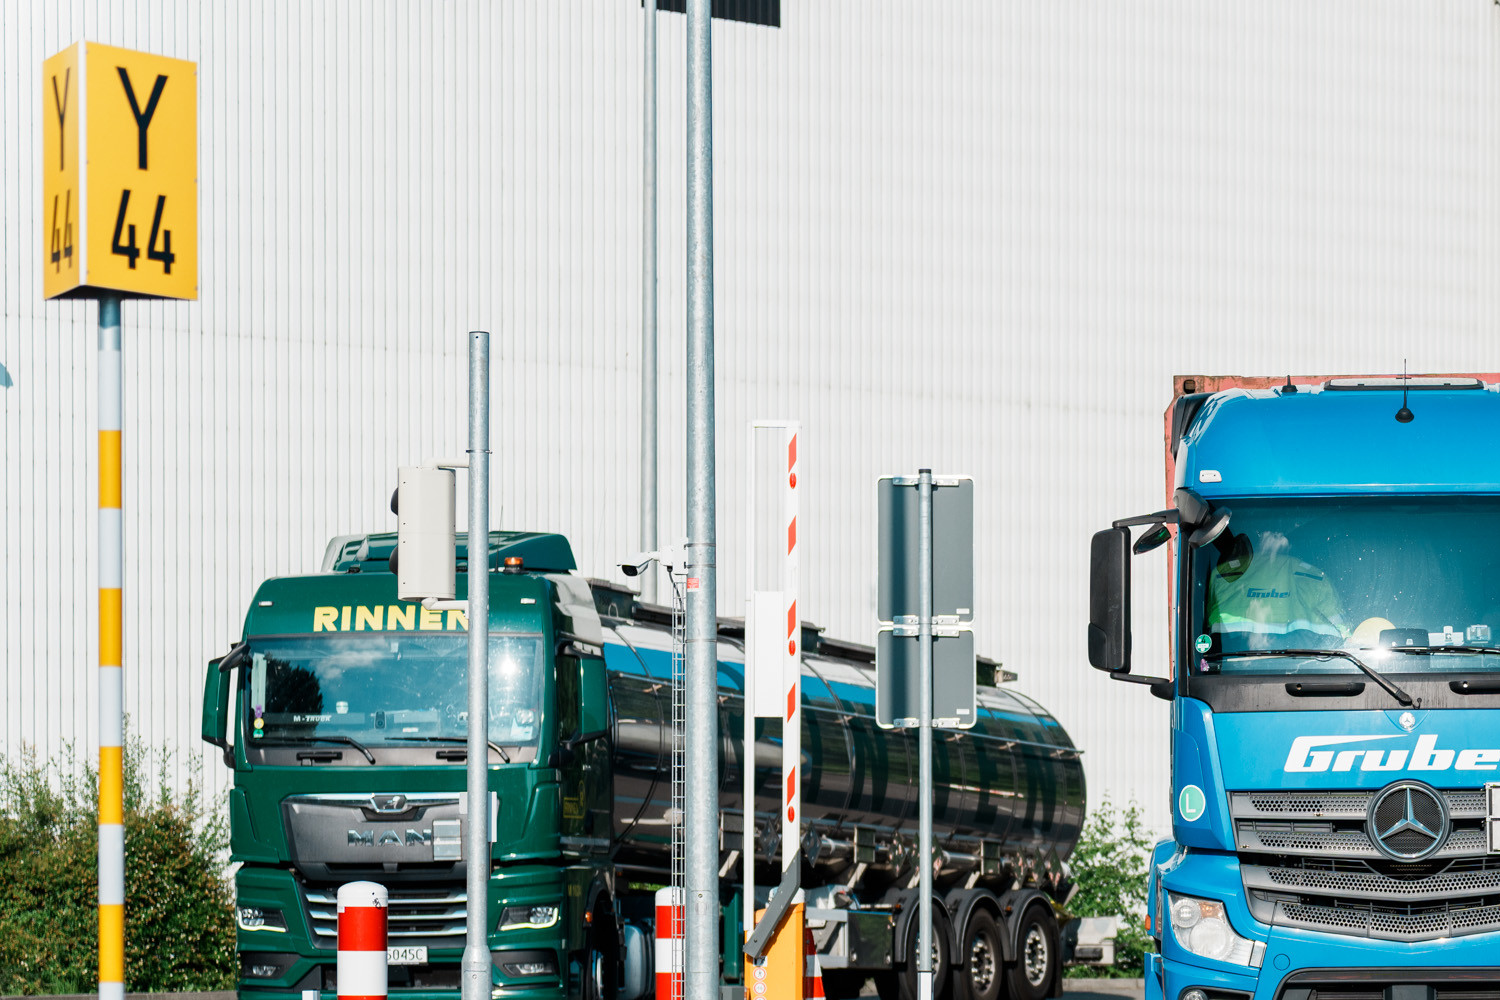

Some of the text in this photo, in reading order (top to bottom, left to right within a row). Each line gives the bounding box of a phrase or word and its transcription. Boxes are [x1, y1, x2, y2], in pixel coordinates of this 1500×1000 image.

[52, 67, 70, 171] Y
[116, 66, 169, 170] Y
[51, 189, 73, 274] 44
[111, 189, 175, 275] 44
[1246, 588, 1291, 598] Grube
[348, 829, 432, 847] MAN
[1185, 793, 1197, 813] L
